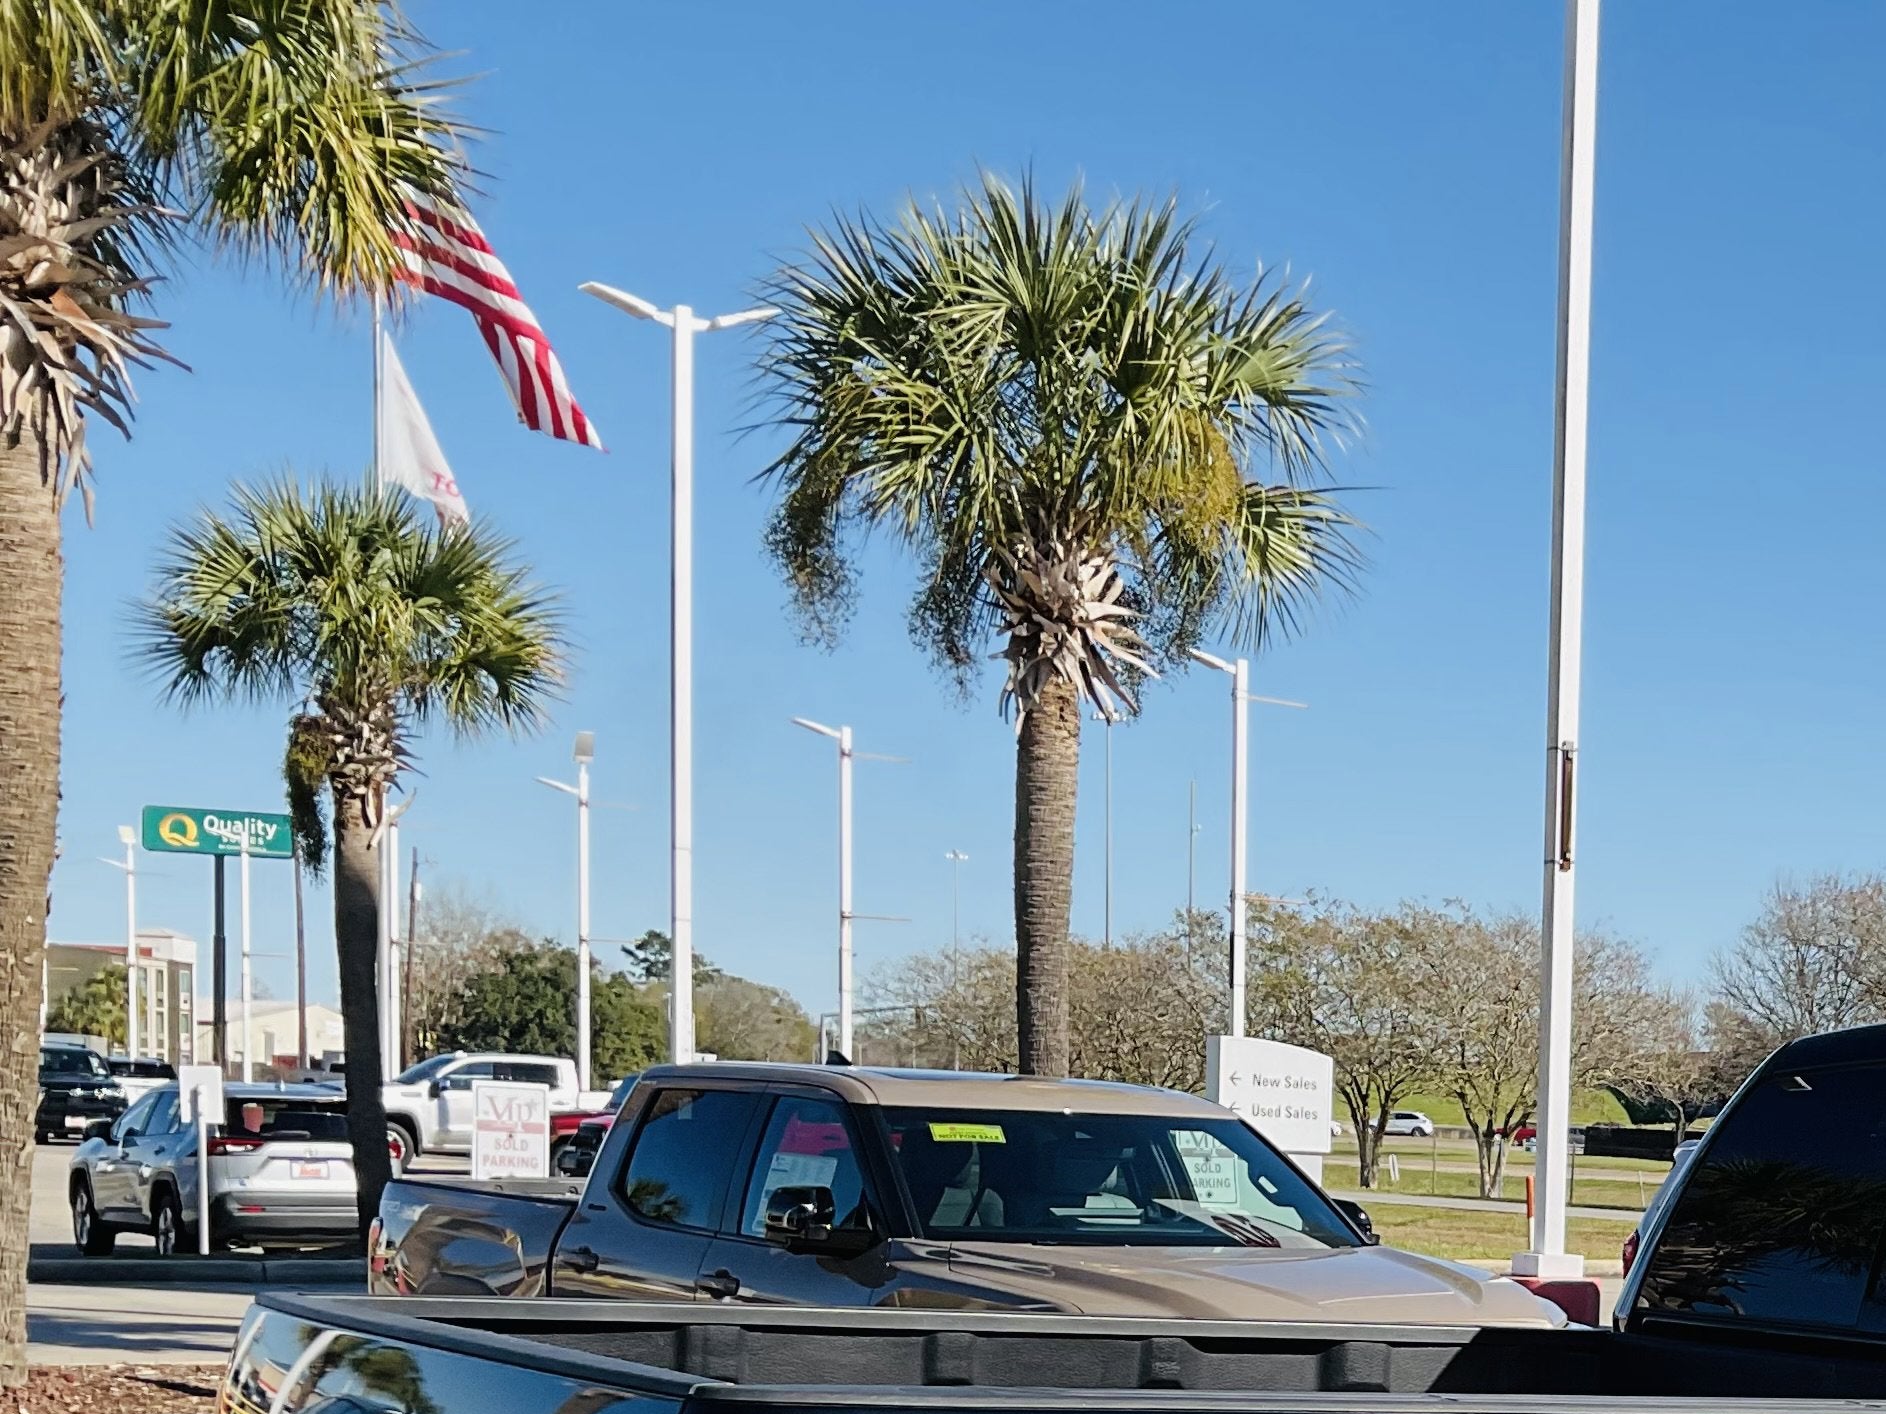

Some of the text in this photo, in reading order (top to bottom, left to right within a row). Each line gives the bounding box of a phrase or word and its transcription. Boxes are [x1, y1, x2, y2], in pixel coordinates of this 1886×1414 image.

[203, 814, 277, 840] Quality
[1252, 1073, 1317, 1090] New Sales
[1251, 1103, 1318, 1120] Used Sales
[494, 1138, 529, 1152] SOLD
[482, 1154, 539, 1169] PARKING
[1193, 1161, 1222, 1174] SOLD
[1193, 1177, 1231, 1189] ARKING
